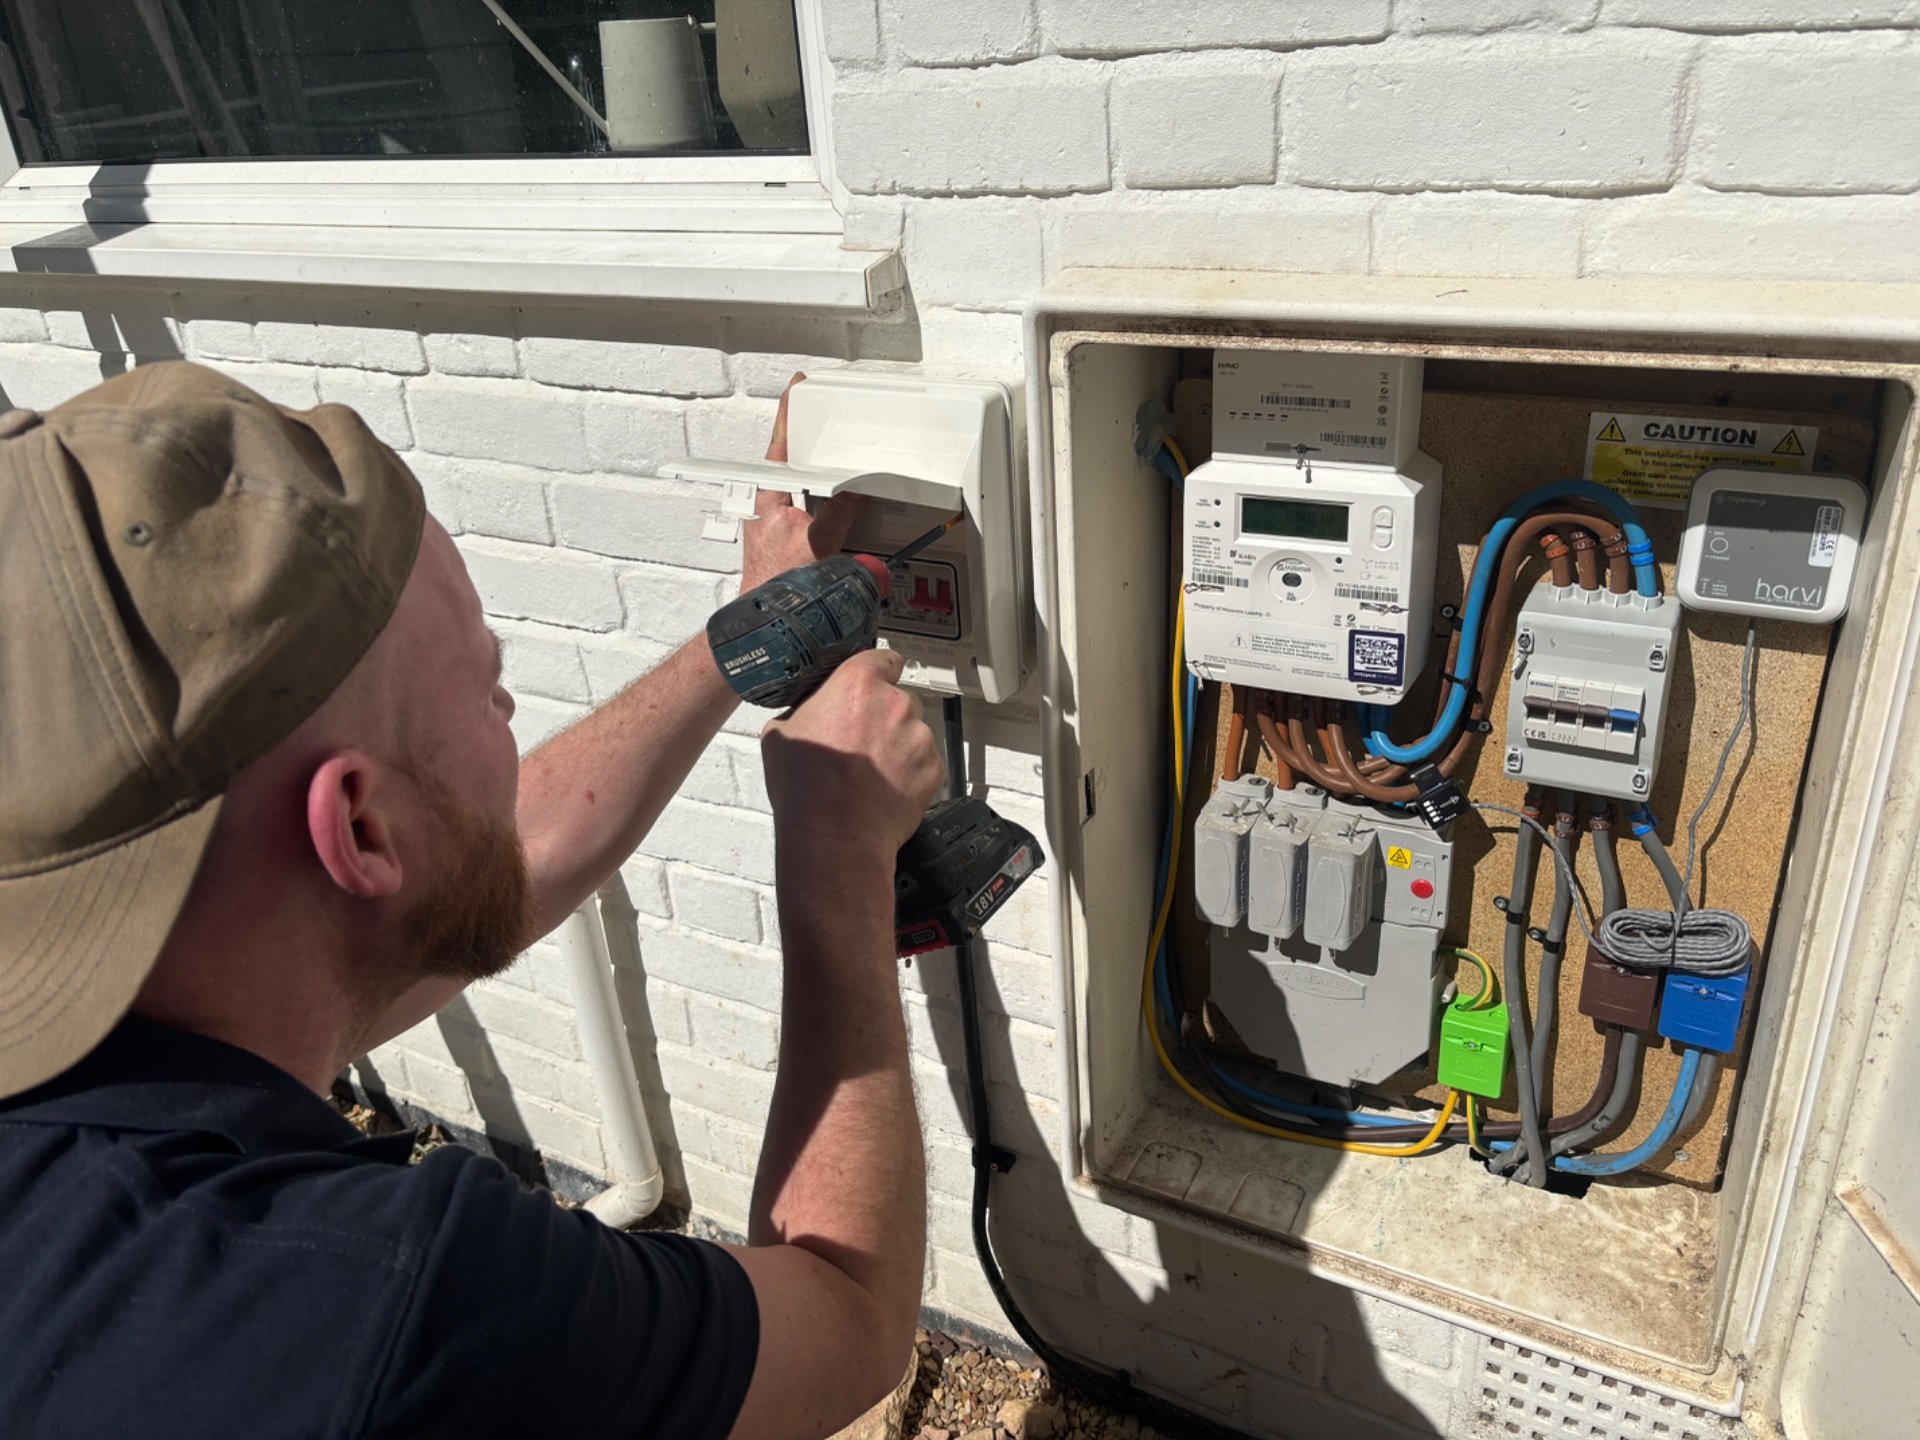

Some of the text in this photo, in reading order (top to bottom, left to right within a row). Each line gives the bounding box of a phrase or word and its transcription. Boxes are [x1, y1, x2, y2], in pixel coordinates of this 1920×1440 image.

[1643, 422, 1758, 445] CAUTION
[1624, 447, 1642, 456] This
[1643, 450, 1693, 461] installation
[1694, 453, 1710, 462] has
[1742, 457, 1777, 467] colours
[1604, 478, 1655, 489] undertaking
[1622, 469, 1646, 478] Great
[1633, 490, 1681, 499] conductors
[1755, 577, 1823, 602] harvi
[724, 646, 767, 670] BRUSHLESS
[973, 888, 995, 916] 18V
